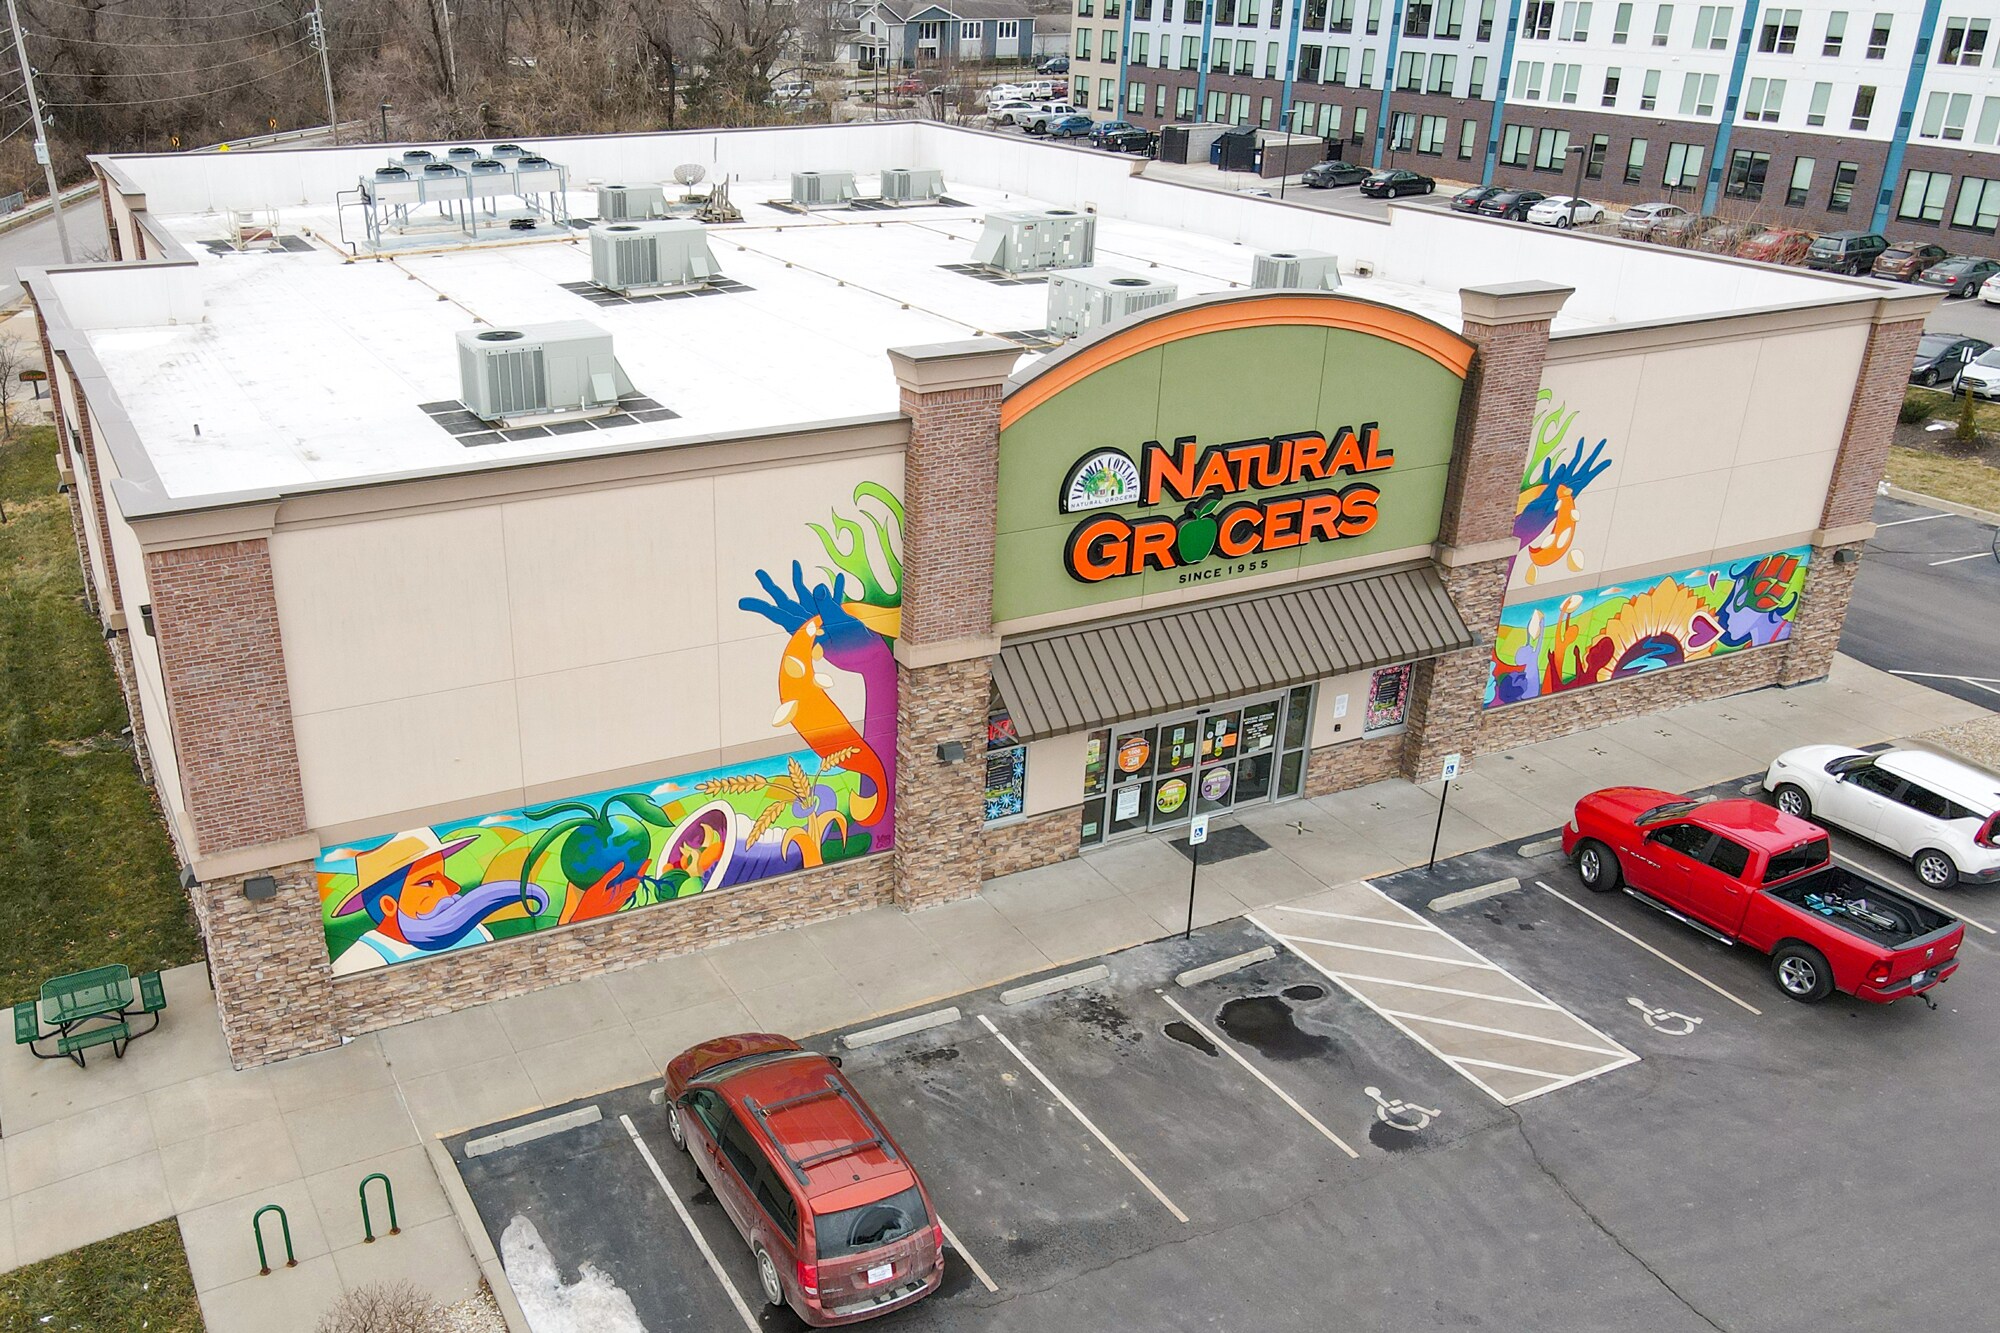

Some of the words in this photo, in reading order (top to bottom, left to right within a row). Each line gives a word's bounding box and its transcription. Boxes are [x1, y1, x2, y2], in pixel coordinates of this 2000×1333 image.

[1071, 459, 1104, 500] VITAMIN
[1107, 457, 1138, 492] COTTAGE
[1144, 424, 1395, 505] NATURAL
[1070, 499, 1102, 508] NATURAL
[1104, 494, 1137, 503] GROCERS
[1178, 567, 1222, 584] SINCE
[1228, 559, 1269, 575] 1955
